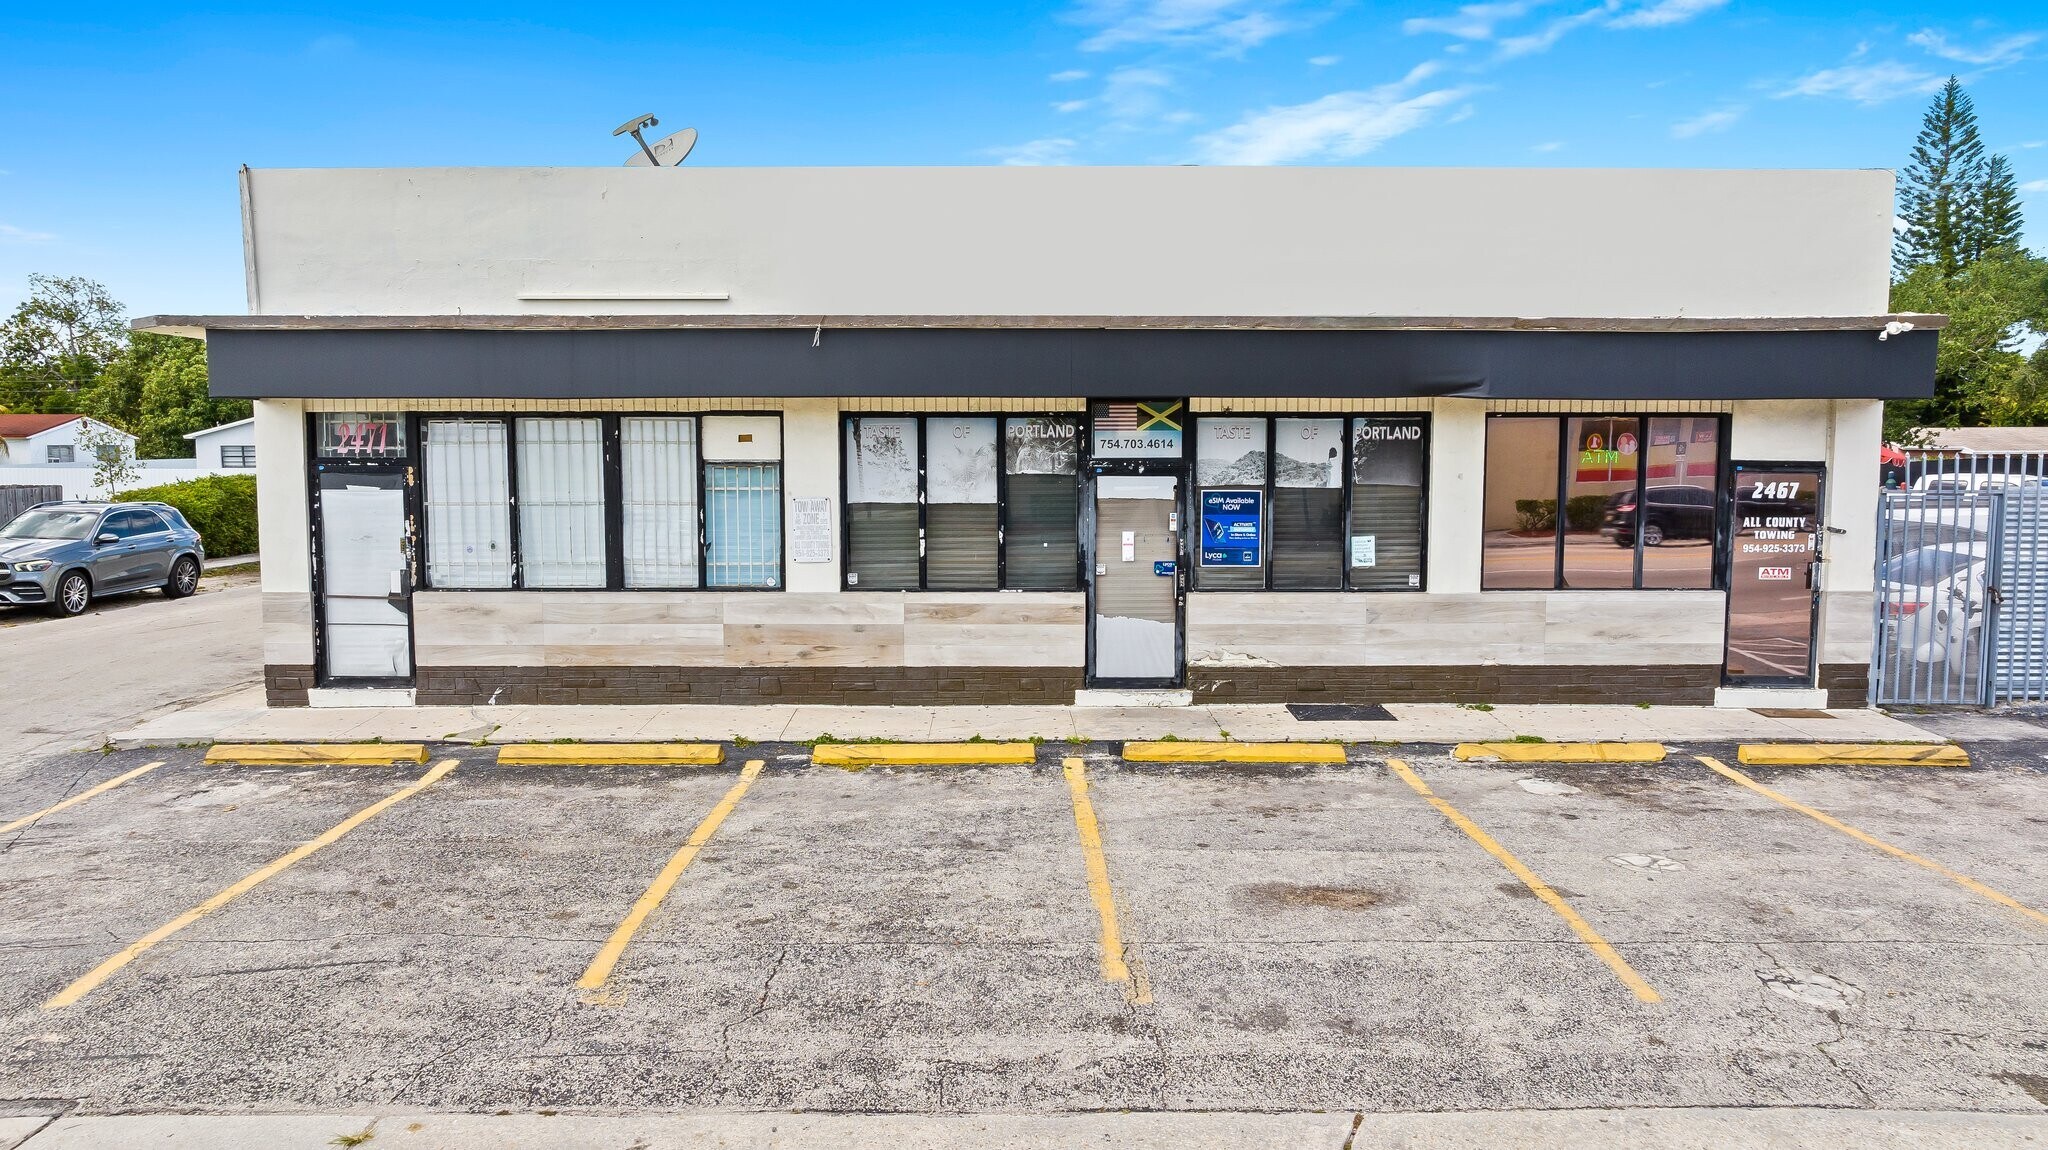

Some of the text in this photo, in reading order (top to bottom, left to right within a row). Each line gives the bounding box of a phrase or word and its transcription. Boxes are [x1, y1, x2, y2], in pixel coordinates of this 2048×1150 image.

[863, 424, 1075, 439] TASTE OF PORTLAND
[1213, 425, 1422, 440] TASTE OF PORTLAND
[337, 422, 387, 454] 2471
[1100, 439, 1174, 449] 754.703.4614
[1581, 450, 1619, 464] ATM
[1752, 481, 1800, 499] 2467
[794, 501, 828, 512] TOW AWAY
[803, 513, 819, 525] ZONE
[1743, 517, 1806, 528] ALL COUNTY
[1753, 531, 1795, 540] TOWING
[1743, 544, 1805, 553] 954-925-3373
[1204, 552, 1223, 560] Lyca
